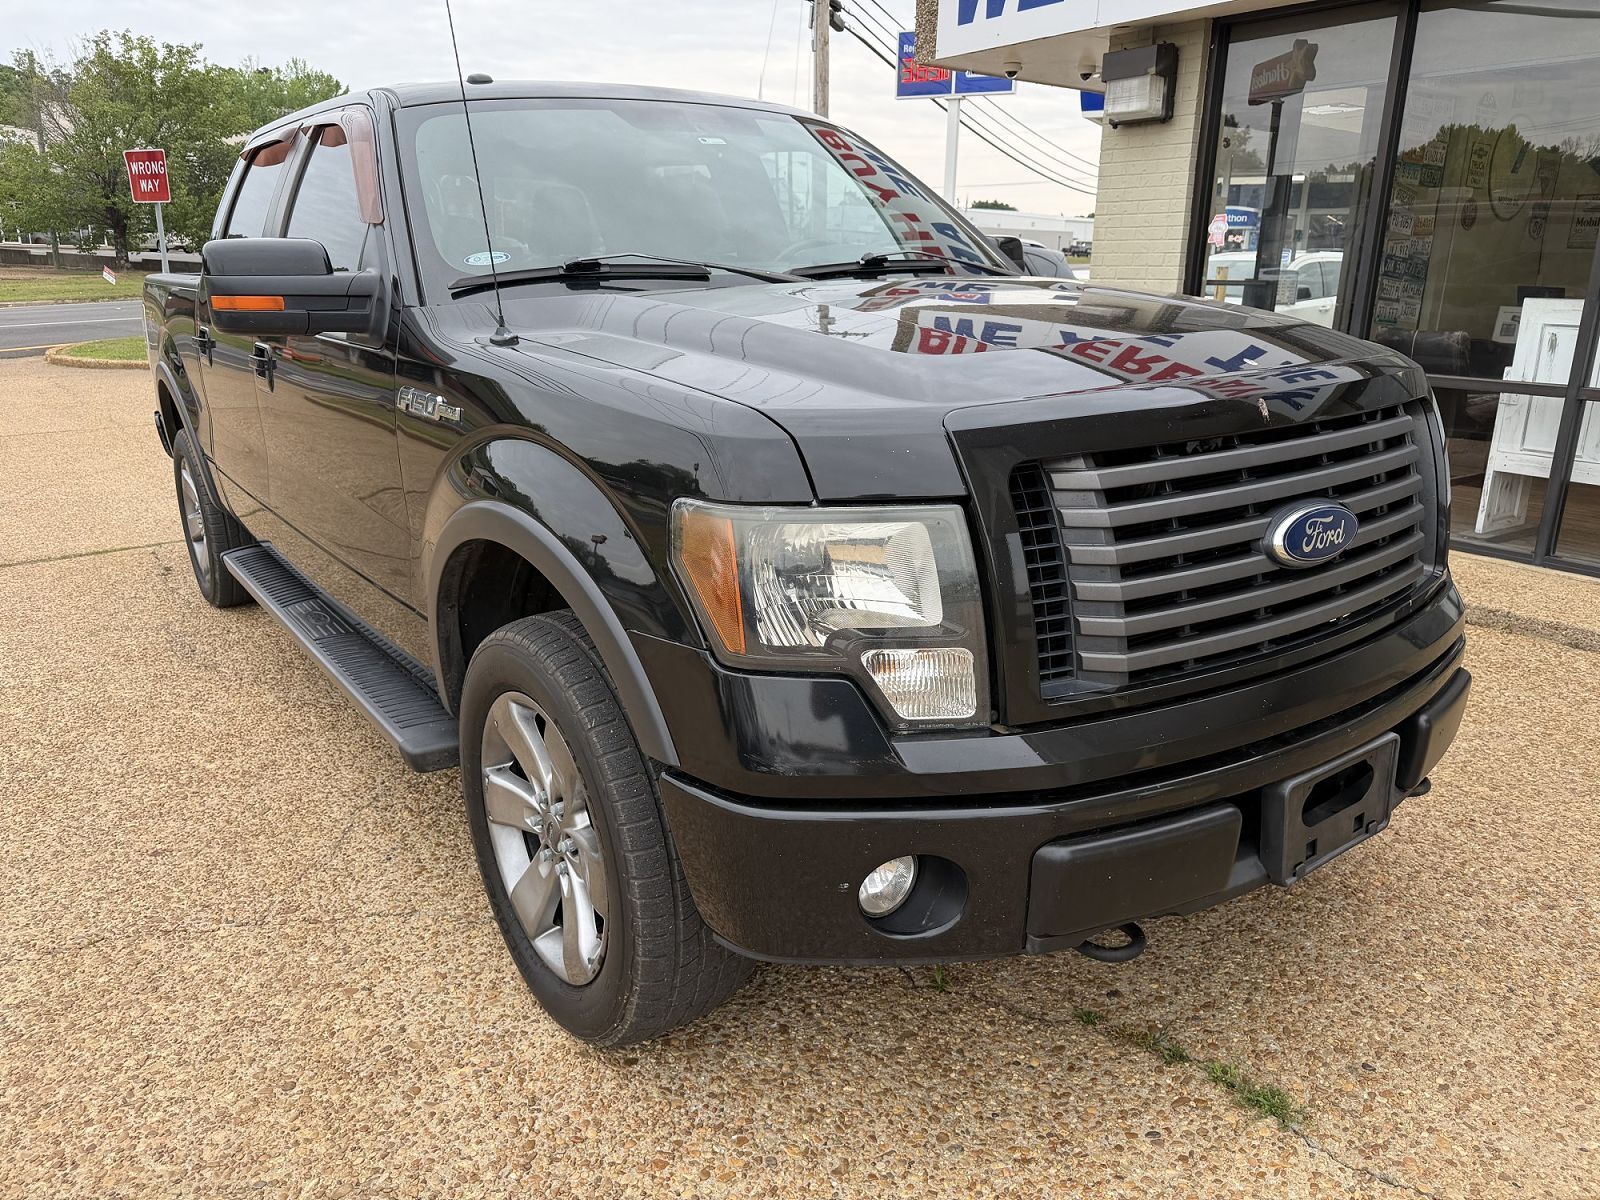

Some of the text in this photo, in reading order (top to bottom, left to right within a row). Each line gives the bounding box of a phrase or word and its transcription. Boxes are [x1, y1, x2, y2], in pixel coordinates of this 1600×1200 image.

[130, 161, 165, 175] WRONG
[139, 179, 160, 193] WAY
[1227, 214, 1248, 223] thon
[1302, 515, 1346, 553] Ford
